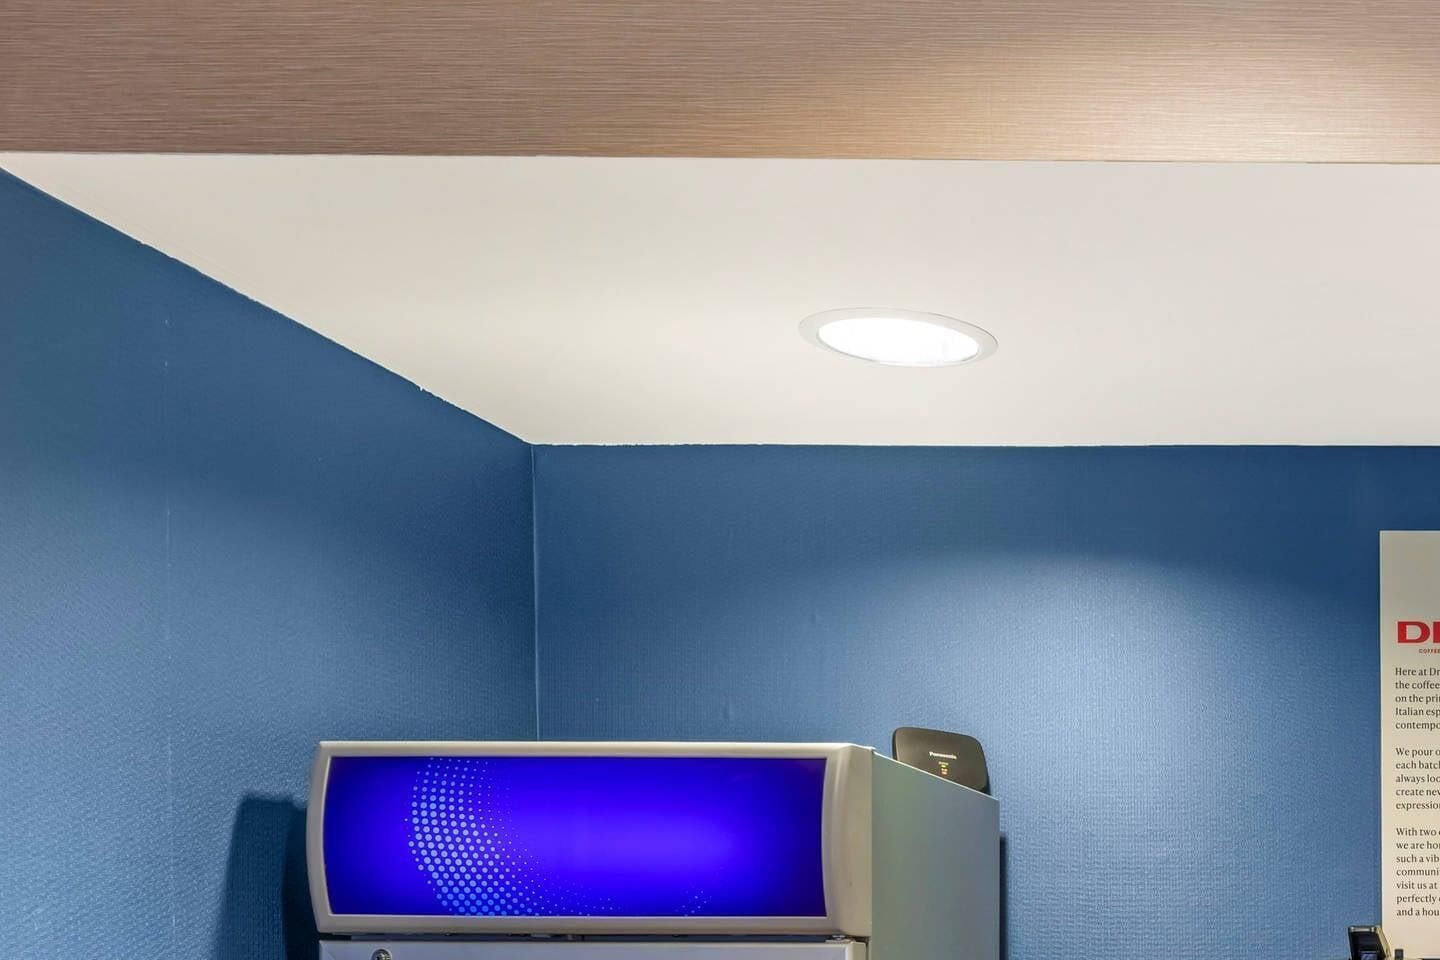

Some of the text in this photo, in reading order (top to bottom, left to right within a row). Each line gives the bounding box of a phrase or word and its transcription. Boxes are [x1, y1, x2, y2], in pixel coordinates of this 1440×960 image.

[1395, 666, 1417, 676] Here
[1418, 667, 1427, 676] at
[1395, 679, 1411, 689] the
[1411, 679, 1440, 689] coffee
[1395, 695, 1407, 703] on
[1408, 693, 1424, 703] the
[1395, 706, 1424, 716] Italian
[1396, 746, 1410, 756] We
[1412, 748, 1432, 759] pour
[1395, 760, 1417, 770] each
[1396, 773, 1425, 786] always
[1395, 787, 1425, 796] create
[1396, 826, 1418, 836] With
[1419, 828, 1437, 836] two
[1396, 842, 1409, 850] we
[1410, 842, 1425, 850] are
[1396, 853, 1417, 863] such
[1418, 855, 1425, 863] a
[1396, 880, 1415, 890] visit
[1417, 882, 1427, 890] us
[1429, 881, 1438, 890] at
[1396, 893, 1437, 906] perfectly
[1397, 907, 1413, 916] and
